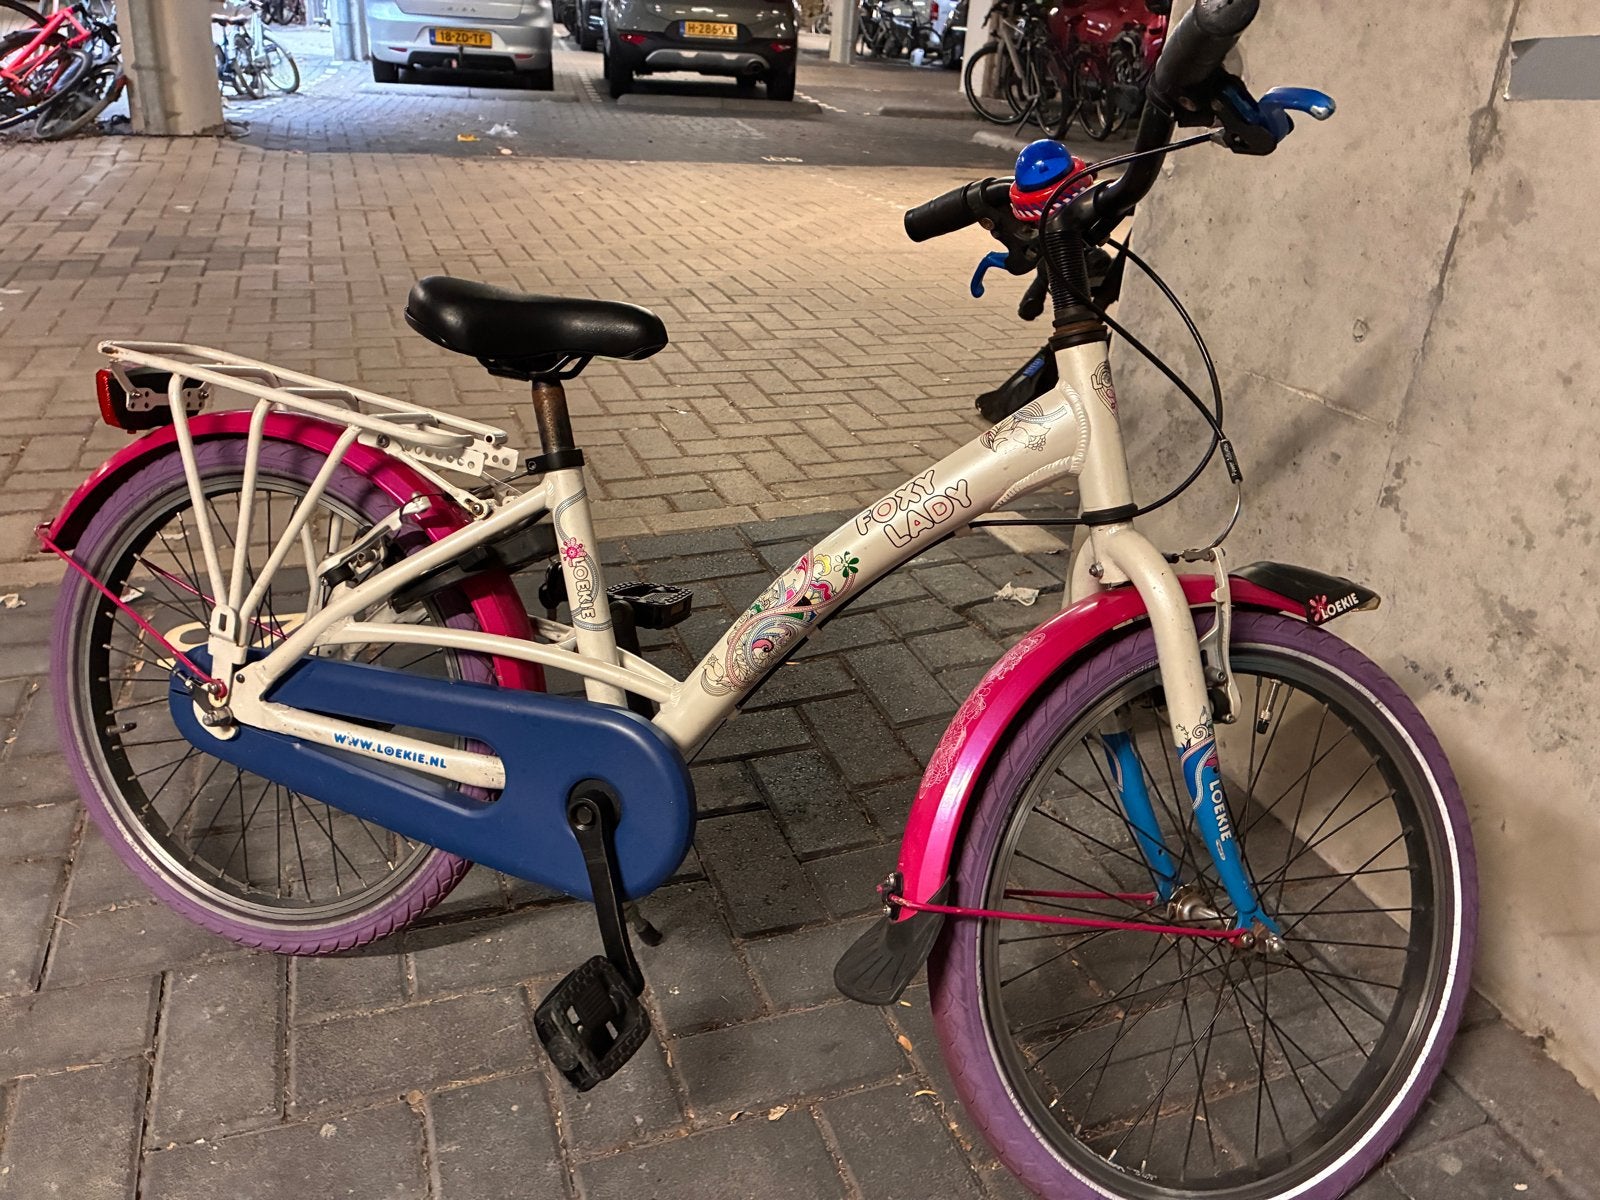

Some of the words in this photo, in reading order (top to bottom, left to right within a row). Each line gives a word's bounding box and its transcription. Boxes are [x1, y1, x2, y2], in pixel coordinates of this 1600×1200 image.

[688, 23, 734, 35] H-286-XK
[855, 469, 936, 536] FOXY
[884, 478, 972, 548] LADY
[571, 556, 596, 620] LOEKIE
[1320, 593, 1358, 619] LOEKIE
[333, 732, 447, 769] WWW.LOEKIE.NL
[1207, 780, 1232, 842] LOEKIE
